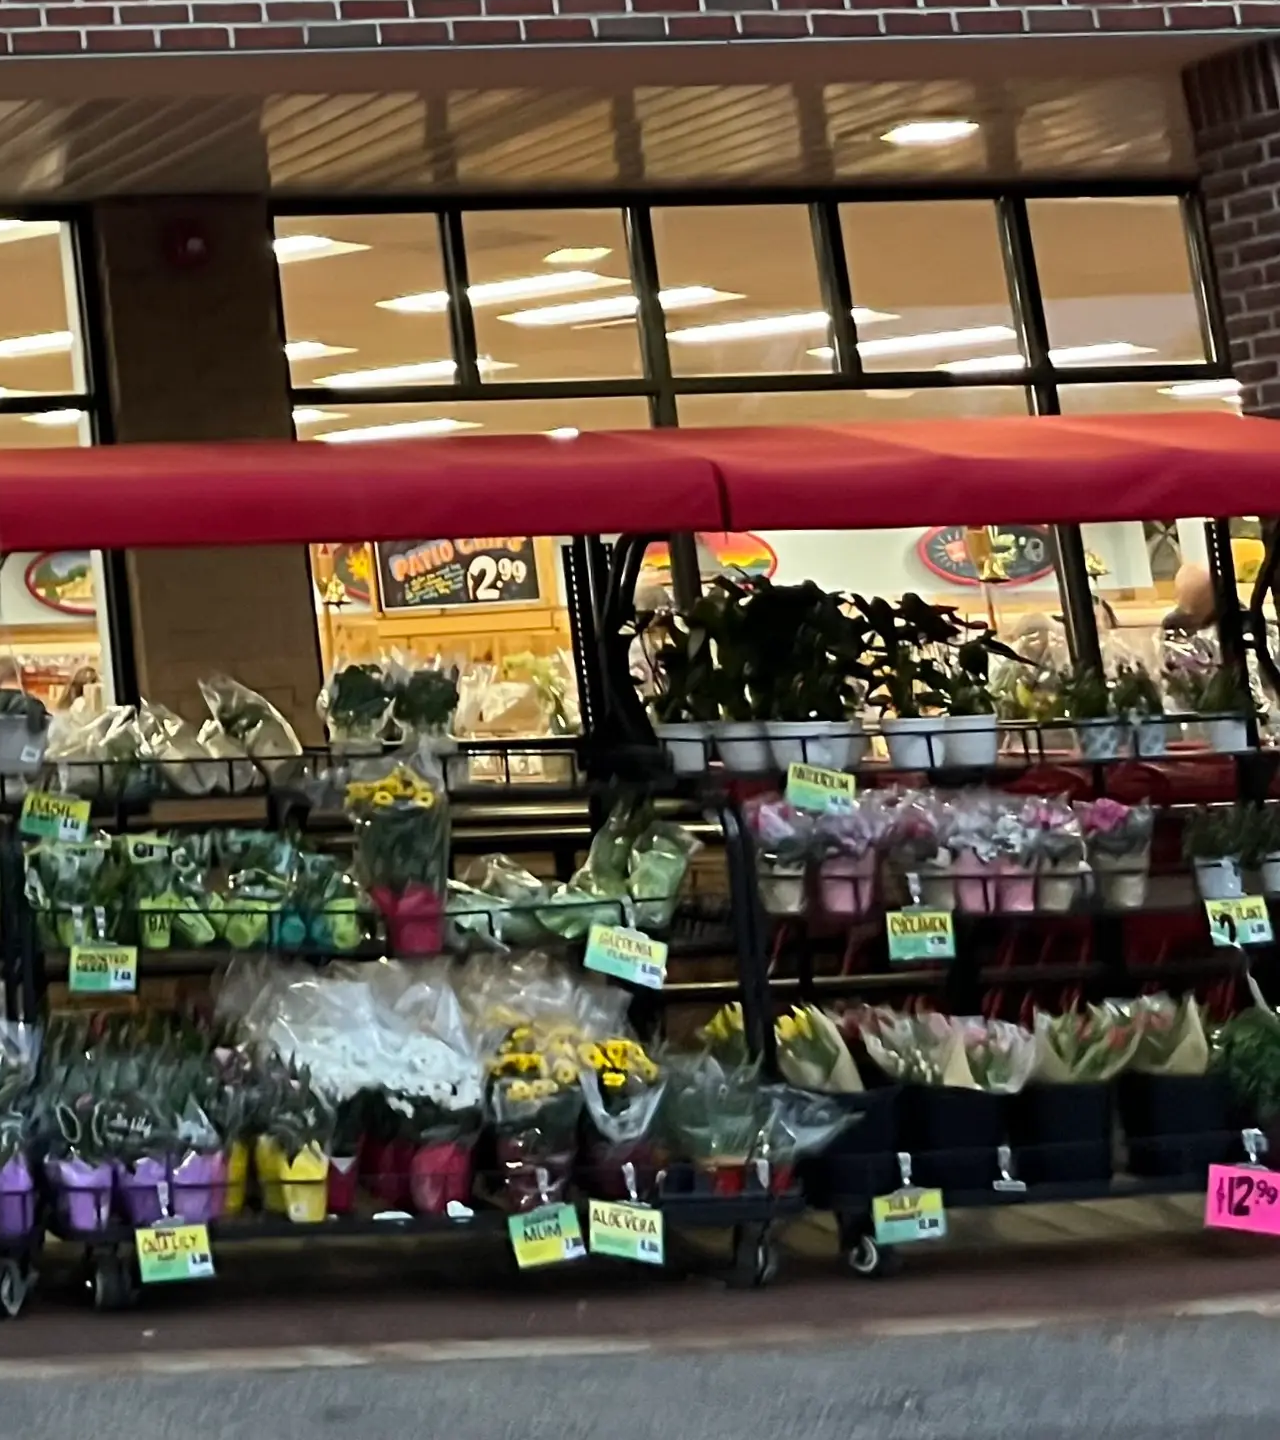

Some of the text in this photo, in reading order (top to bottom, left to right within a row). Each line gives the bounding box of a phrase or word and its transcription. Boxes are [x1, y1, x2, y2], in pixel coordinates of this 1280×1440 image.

[389, 540, 454, 582] PATIO
[468, 554, 527, 600] 2.99
[1216, 1175, 1279, 1216] $12.99
[523, 1222, 562, 1243] MUM
[593, 1208, 657, 1235] ALOE VERA
